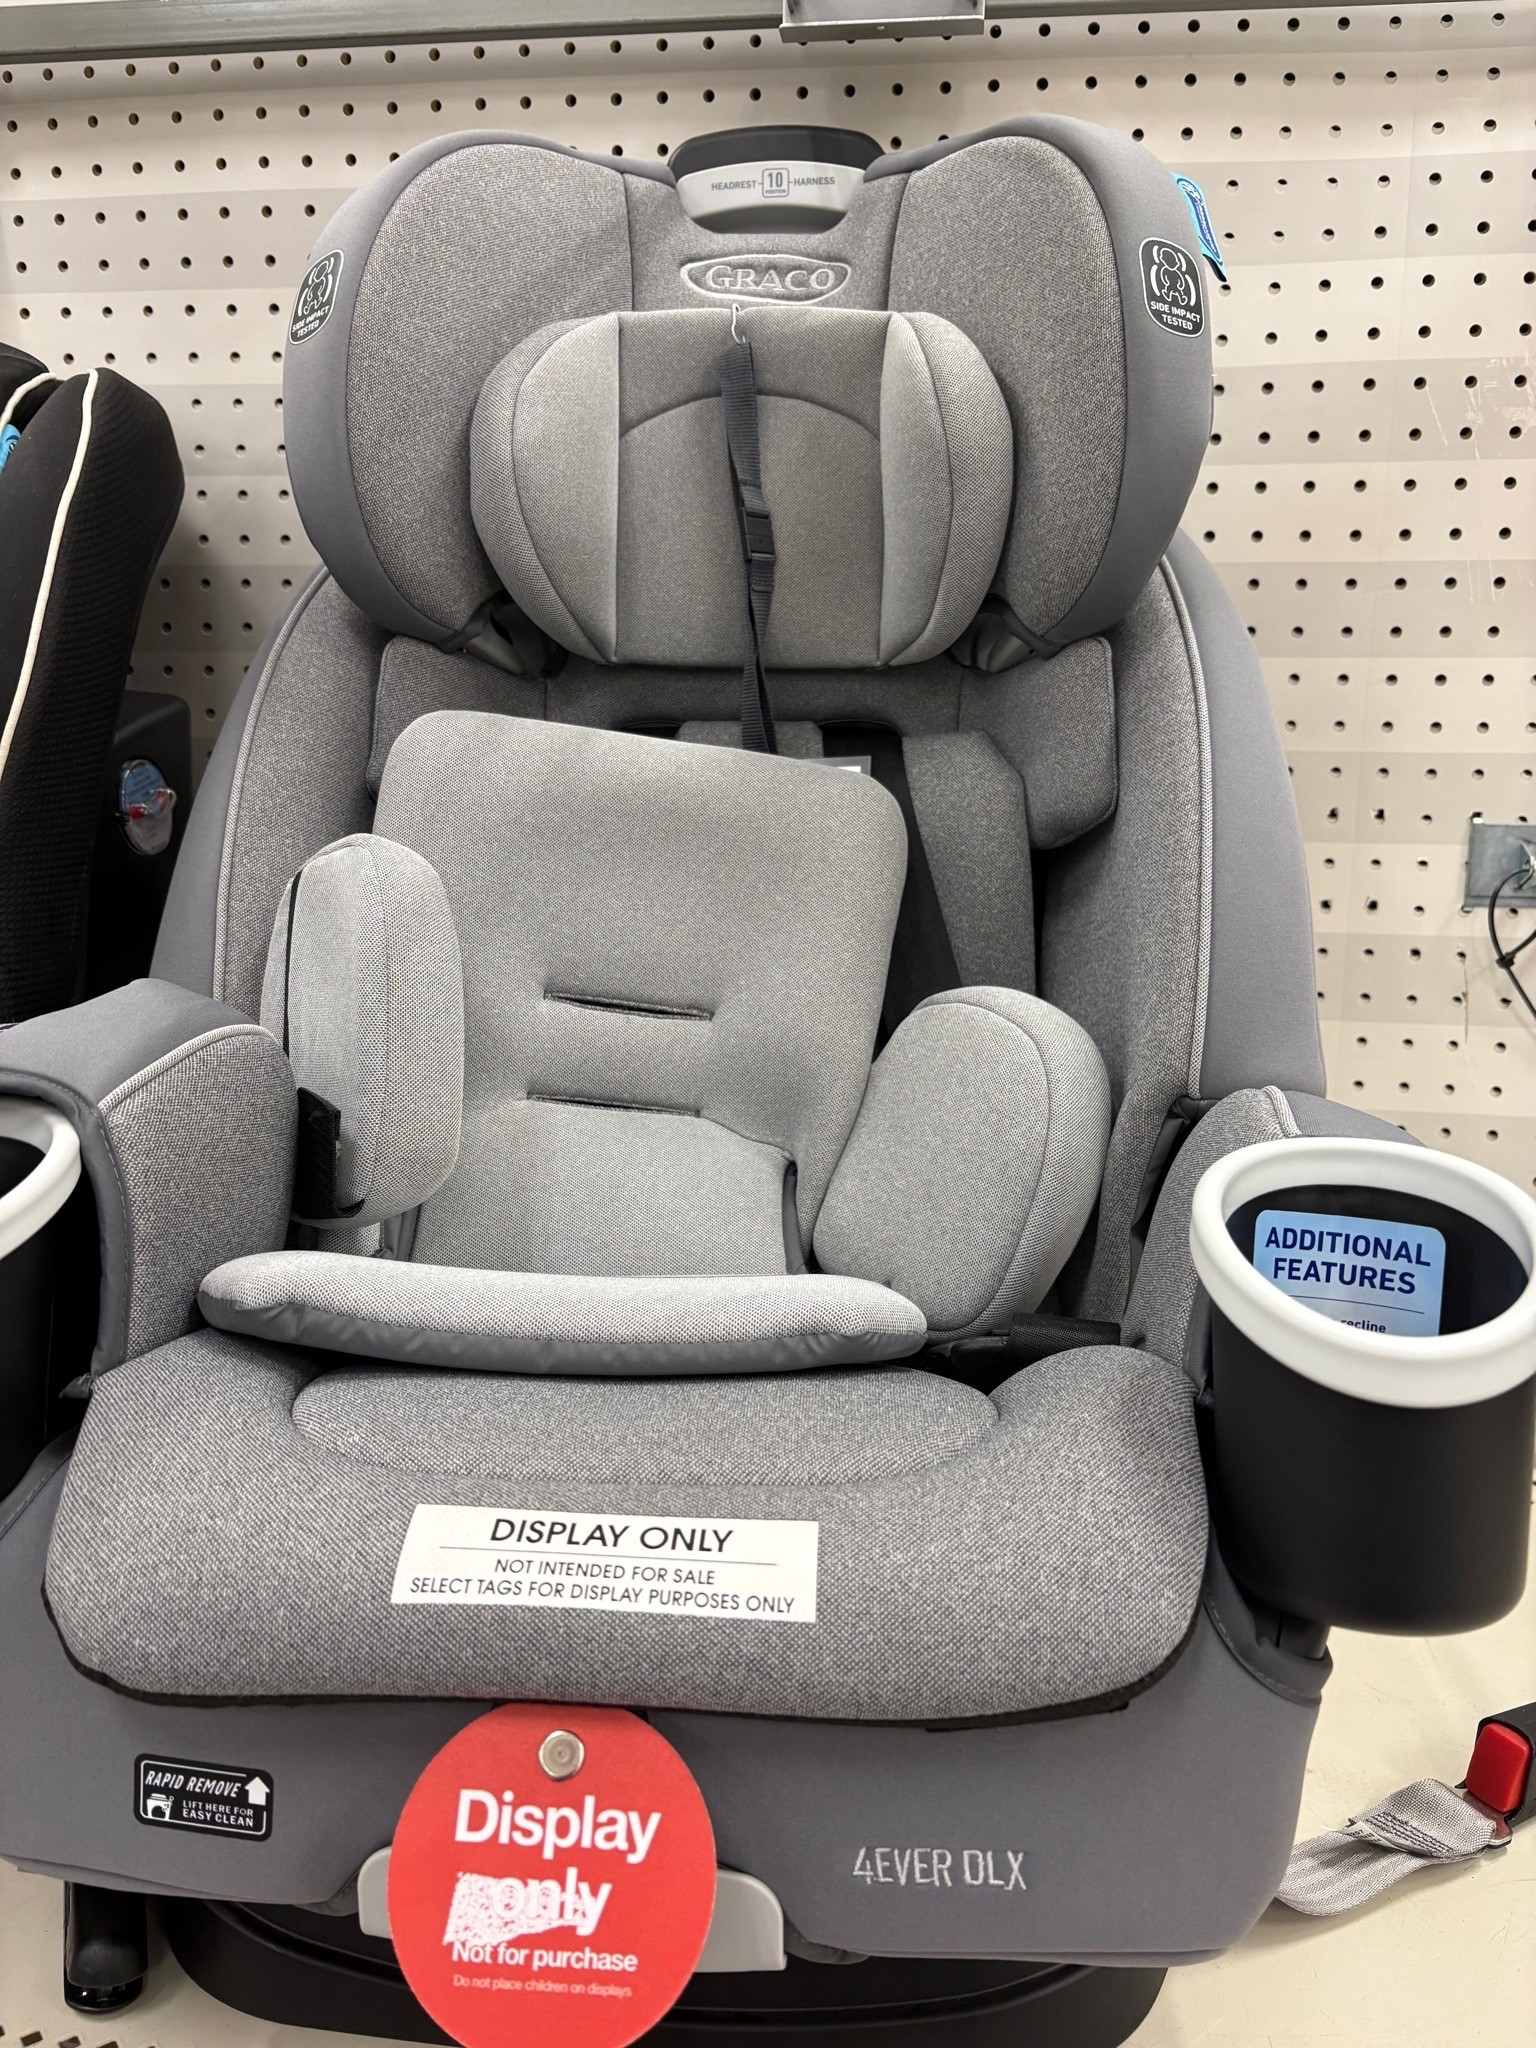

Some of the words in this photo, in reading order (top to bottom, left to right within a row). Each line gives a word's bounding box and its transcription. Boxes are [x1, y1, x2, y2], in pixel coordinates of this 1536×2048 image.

[711, 180, 757, 191] HEADREST
[768, 172, 783, 188] 10
[793, 177, 835, 186] HARNESS
[705, 265, 836, 292] GRACO
[292, 319, 305, 332] SIDE
[306, 306, 329, 324] IMPACT
[1150, 301, 1170, 313] SIDE
[1171, 306, 1201, 323] IMPACT
[1161, 314, 1193, 330] TESTED
[297, 320, 320, 338] TESTED
[1265, 1226, 1431, 1267] ADDITIONAL
[1273, 1257, 1416, 1295] FEATURES
[490, 1518, 630, 1548] DISPLAY
[640, 1527, 734, 1552] ONLY
[494, 1559, 534, 1573] NOT
[538, 1561, 626, 1579] INTENDED
[631, 1566, 668, 1582] FOR
[673, 1568, 716, 1585] SALE
[410, 1577, 473, 1594] SELECT
[477, 1579, 523, 1596] TAGS
[528, 1581, 565, 1598] FOR
[570, 1584, 643, 1603] DISPLAY
[648, 1589, 740, 1610] PURPOSES
[746, 1595, 795, 1614] ONLY
[145, 1770, 185, 1790] RAPID
[186, 1776, 242, 1798] REMOVE
[182, 1800, 202, 1810] LIFT
[205, 1803, 231, 1814] HERE
[233, 1807, 254, 1817] FOR
[182, 1808, 212, 1821] EASY
[214, 1812, 254, 1828] CLEAN
[454, 1788, 662, 1865] Display
[852, 1846, 953, 1887] 4EVER
[962, 1849, 1028, 1891] DLX
[493, 1866, 613, 1937] only
[451, 1940, 494, 1964] Not
[498, 1944, 529, 1966] for
[532, 1947, 639, 1972] purchase
[453, 1974, 470, 1988] Do
[472, 1976, 491, 1990] not
[492, 1976, 523, 1991] place
[524, 1979, 568, 1994] children
[570, 1983, 586, 1995] on
[587, 1982, 633, 1999] displays
